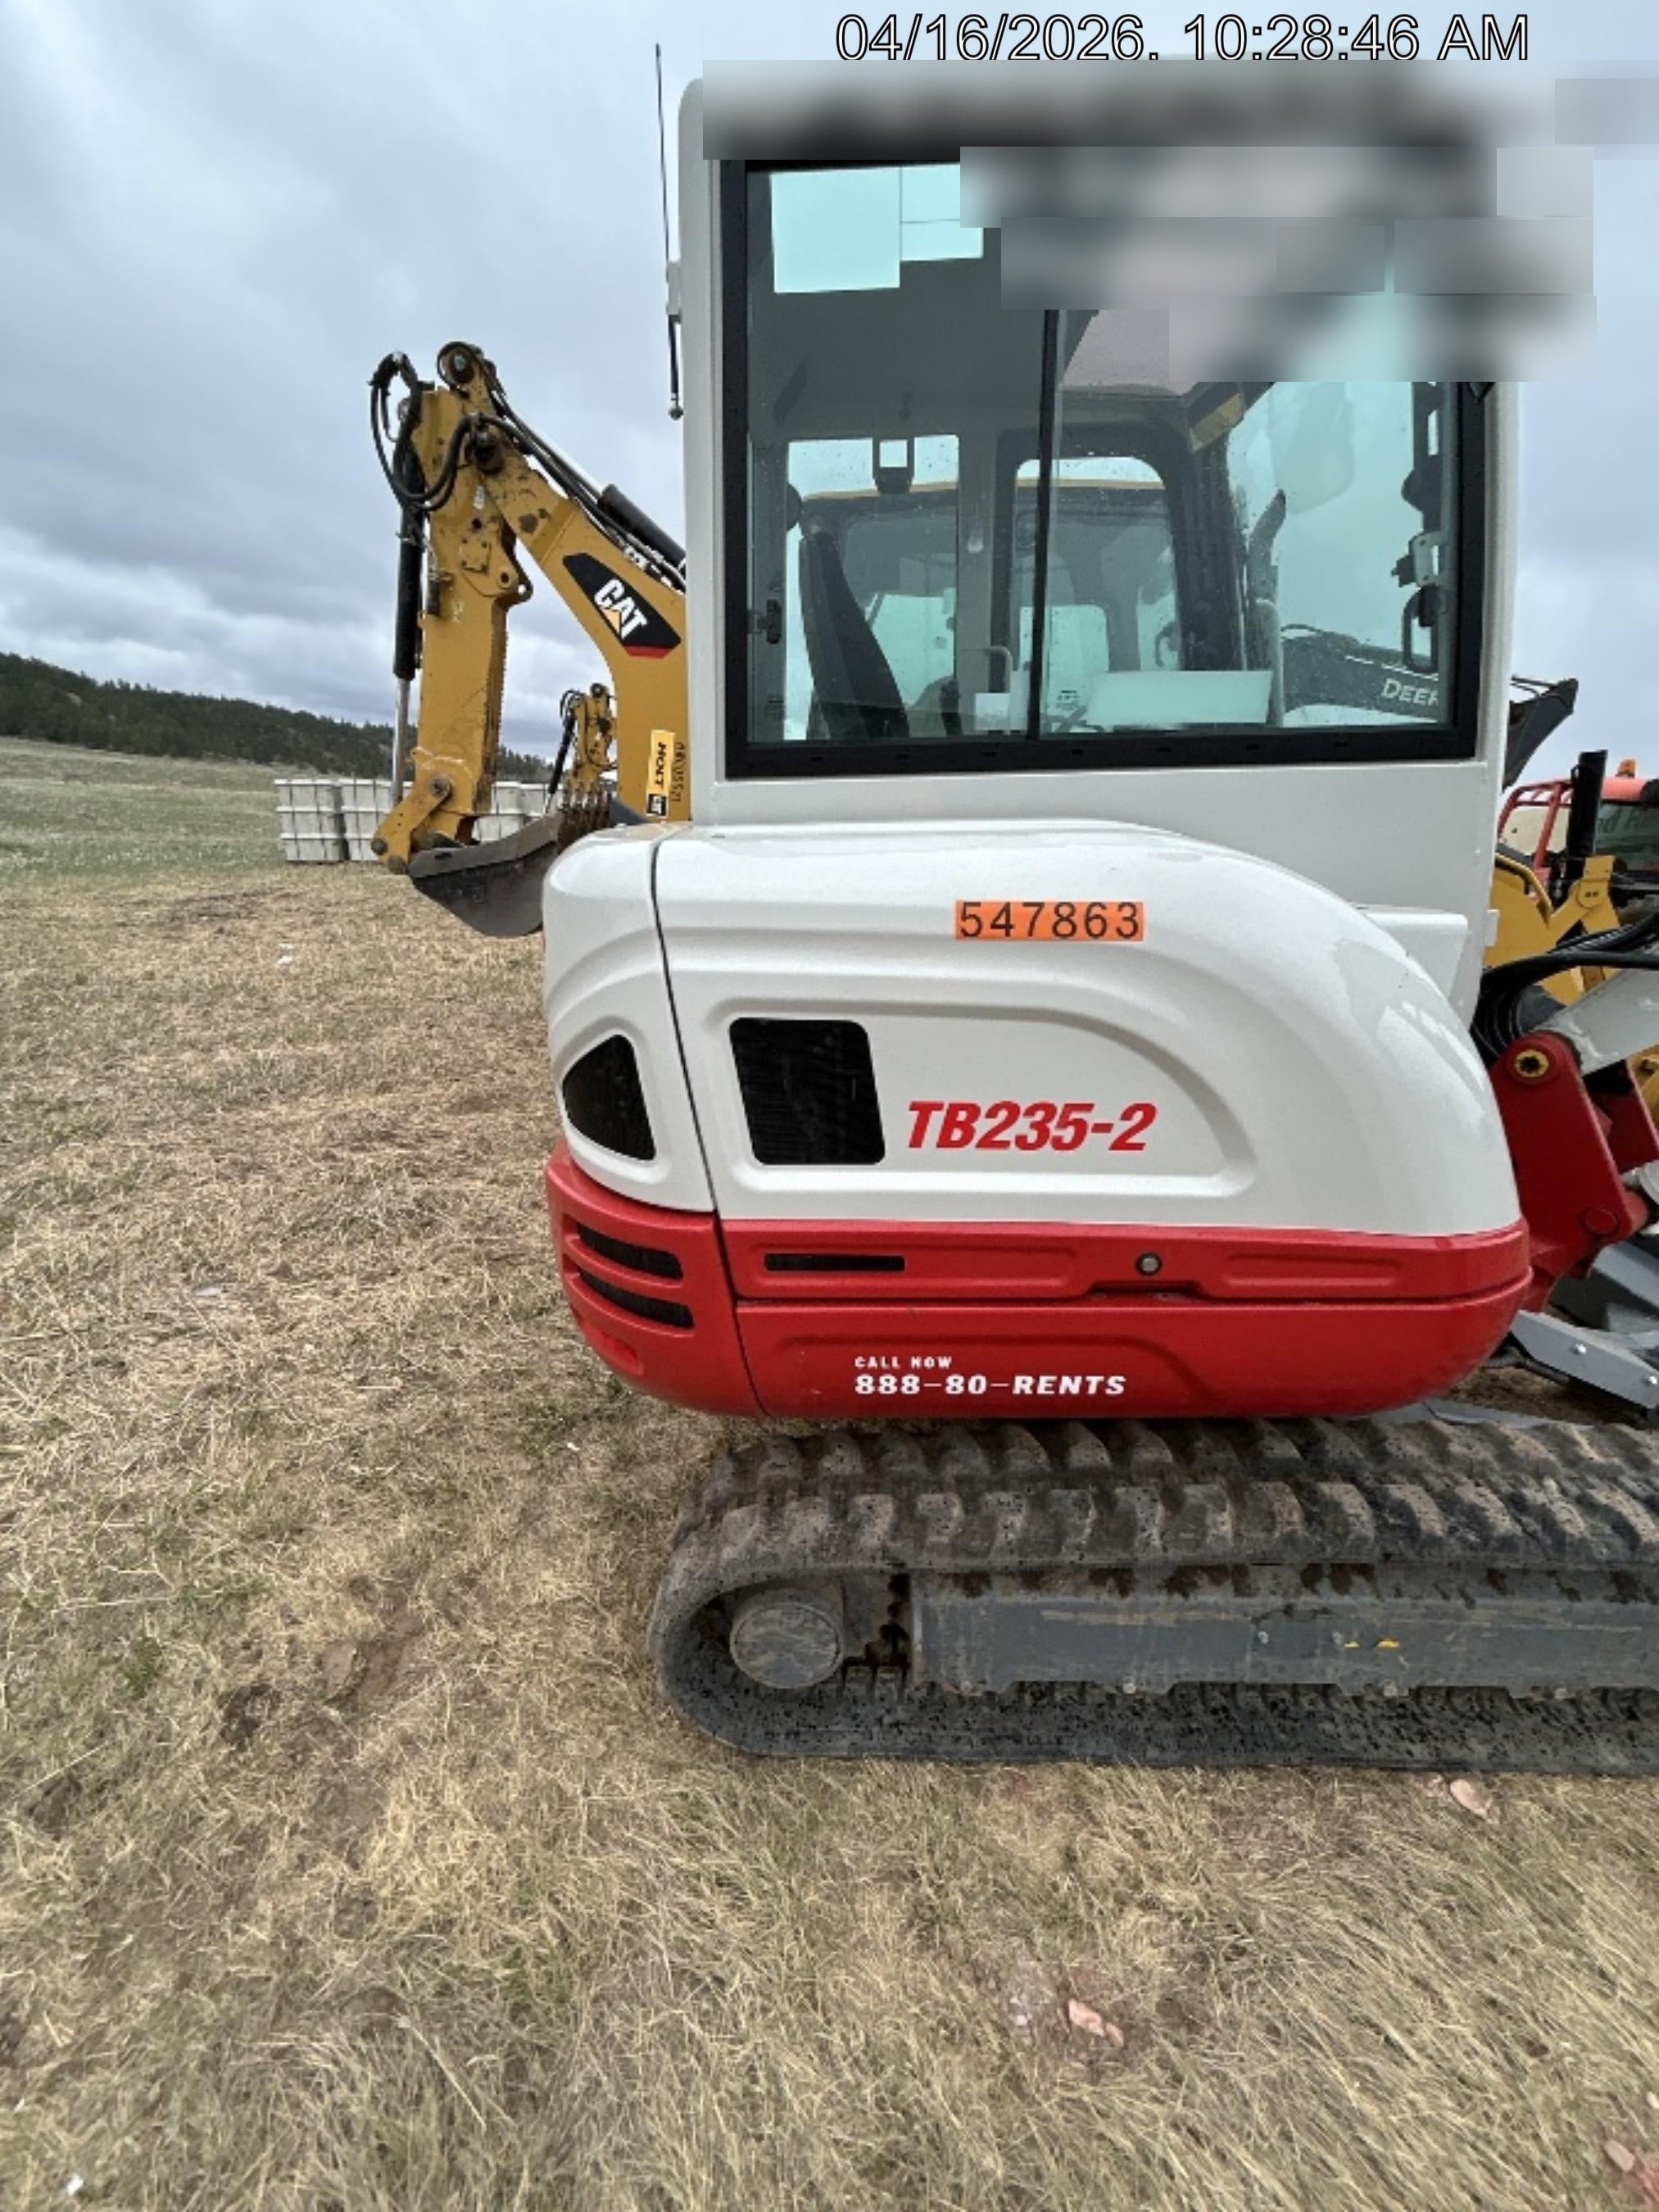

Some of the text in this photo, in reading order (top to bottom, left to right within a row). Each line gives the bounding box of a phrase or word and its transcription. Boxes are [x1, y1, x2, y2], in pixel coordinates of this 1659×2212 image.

[593, 578, 648, 640] CAT
[960, 902, 1140, 938] 547863
[908, 1100, 1158, 1151] TB235-2
[854, 1356, 952, 1369] CALL NOW
[854, 1373, 1126, 1395] 888-80-RENTS
